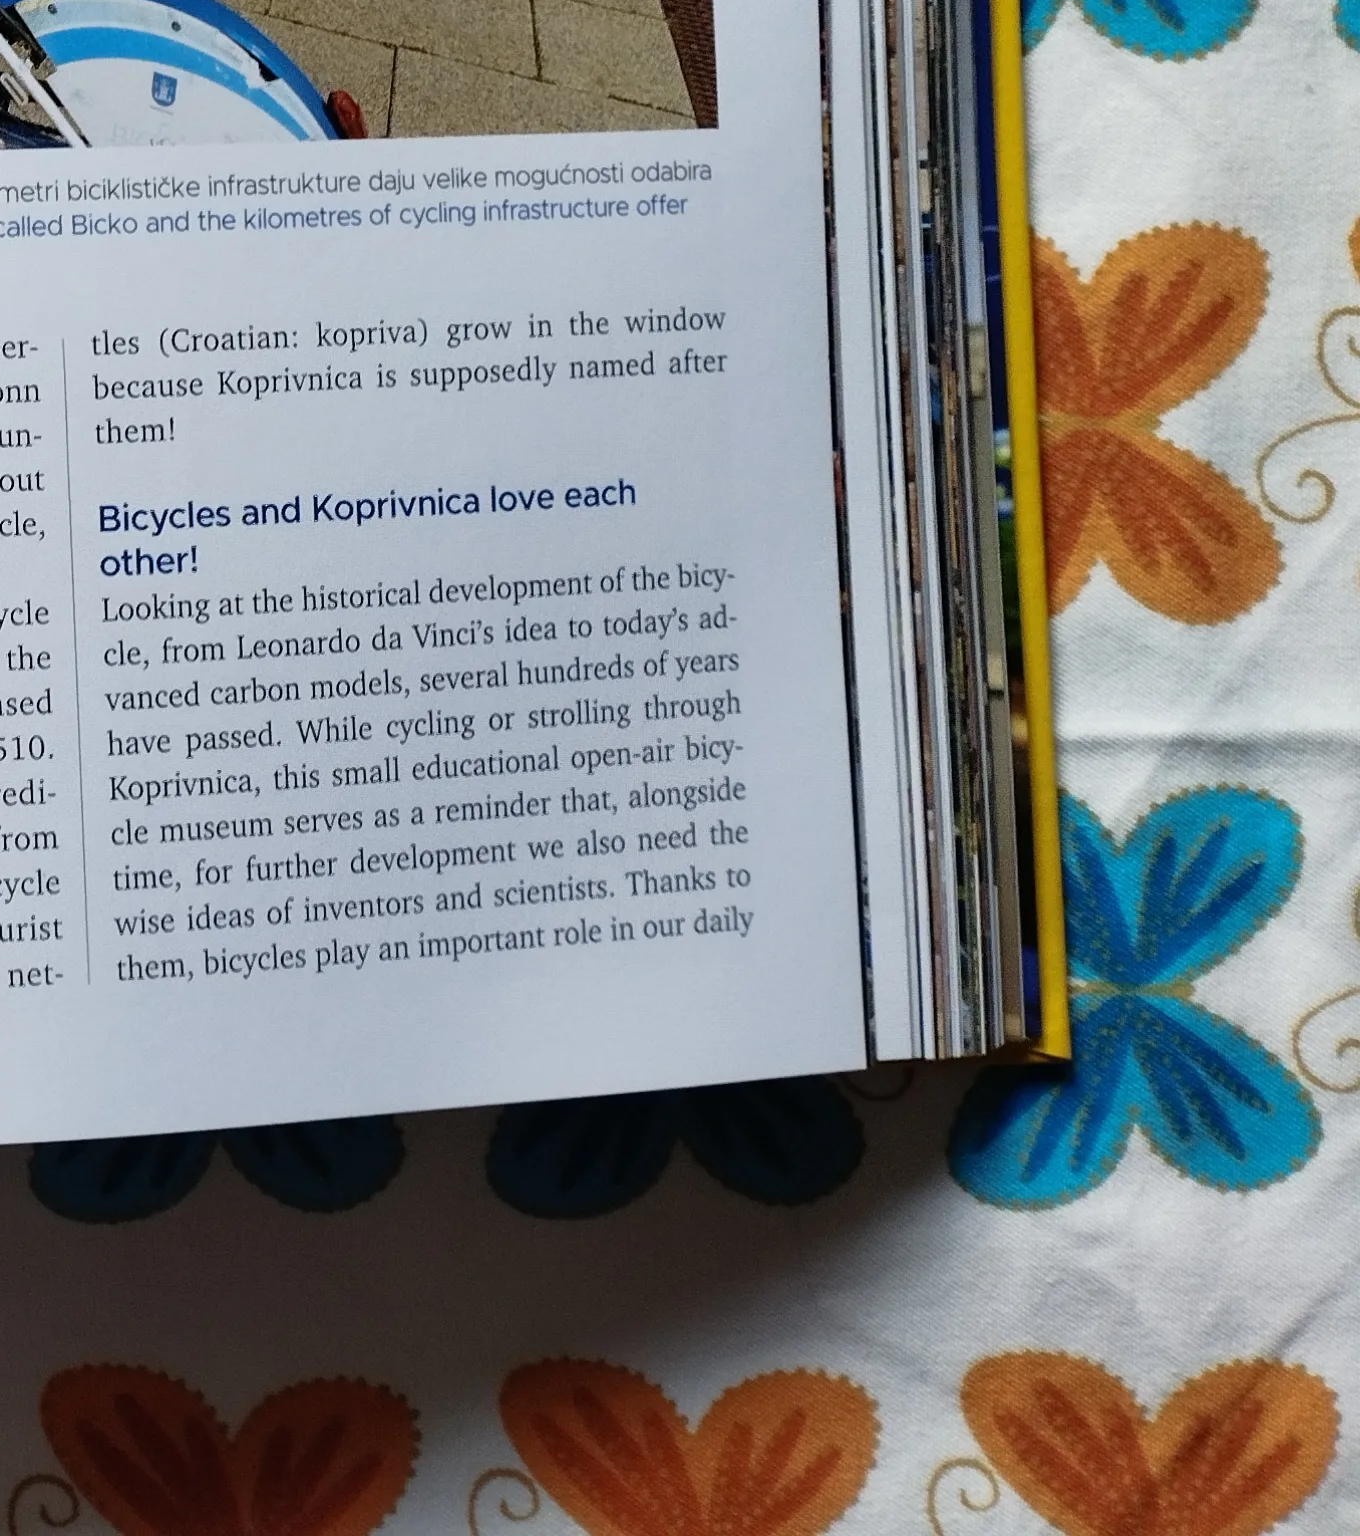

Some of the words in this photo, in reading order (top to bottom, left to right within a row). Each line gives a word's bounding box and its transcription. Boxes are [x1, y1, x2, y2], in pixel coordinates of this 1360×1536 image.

[67, 175, 201, 202] biciklističke
[208, 171, 361, 197] infrastrukture
[368, 168, 415, 196] daju
[422, 166, 488, 190] velike
[494, 161, 624, 191] mogućnosti
[630, 160, 713, 183] odabira
[90, 328, 140, 357] tles
[159, 324, 298, 359] (Croatian:
[315, 317, 428, 354] kopriva)
[446, 320, 513, 349] grow
[528, 312, 553, 339] in
[568, 310, 610, 337] the
[623, 305, 727, 335] window
[98, 499, 232, 538] Bicycles
[241, 494, 301, 527] and
[312, 486, 481, 528] Koprivnica
[490, 484, 555, 513] love
[563, 477, 637, 509] each
[99, 544, 199, 578] other!
[7, 643, 51, 672] the
[103, 679, 201, 712] vanced
[210, 676, 302, 706] carbon
[309, 668, 411, 701] models,
[419, 660, 509, 693] several
[516, 652, 635, 687] hundreds
[643, 648, 670, 678] of
[673, 652, 740, 683] years
